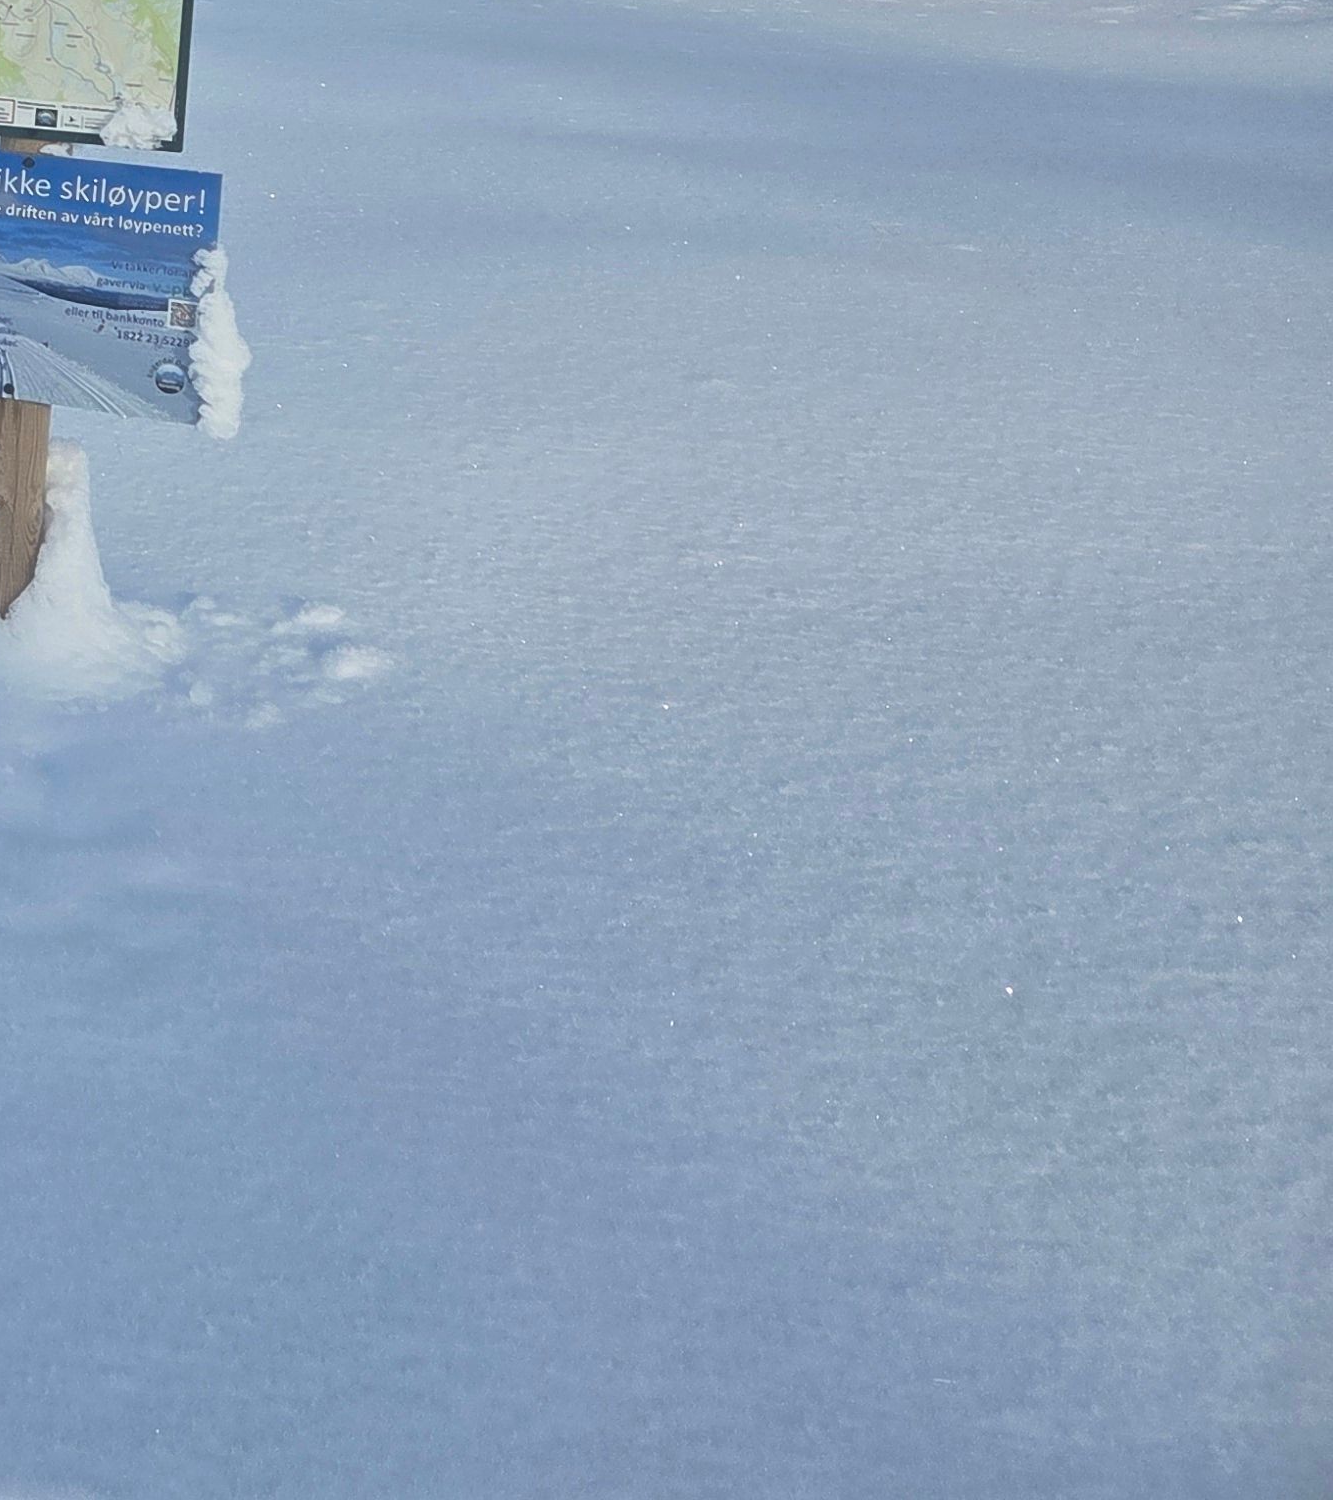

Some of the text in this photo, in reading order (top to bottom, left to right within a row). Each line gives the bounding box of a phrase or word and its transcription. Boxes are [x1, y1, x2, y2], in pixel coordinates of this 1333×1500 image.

[59, 175, 206, 215] skiløyper!
[5, 203, 57, 222] driften
[60, 212, 80, 224] av
[83, 213, 114, 228] vårt
[118, 216, 205, 238] løypenett?
[96, 277, 128, 288] gaver
[65, 307, 165, 328] eller til bankkonto
[117, 330, 143, 342] 1822
